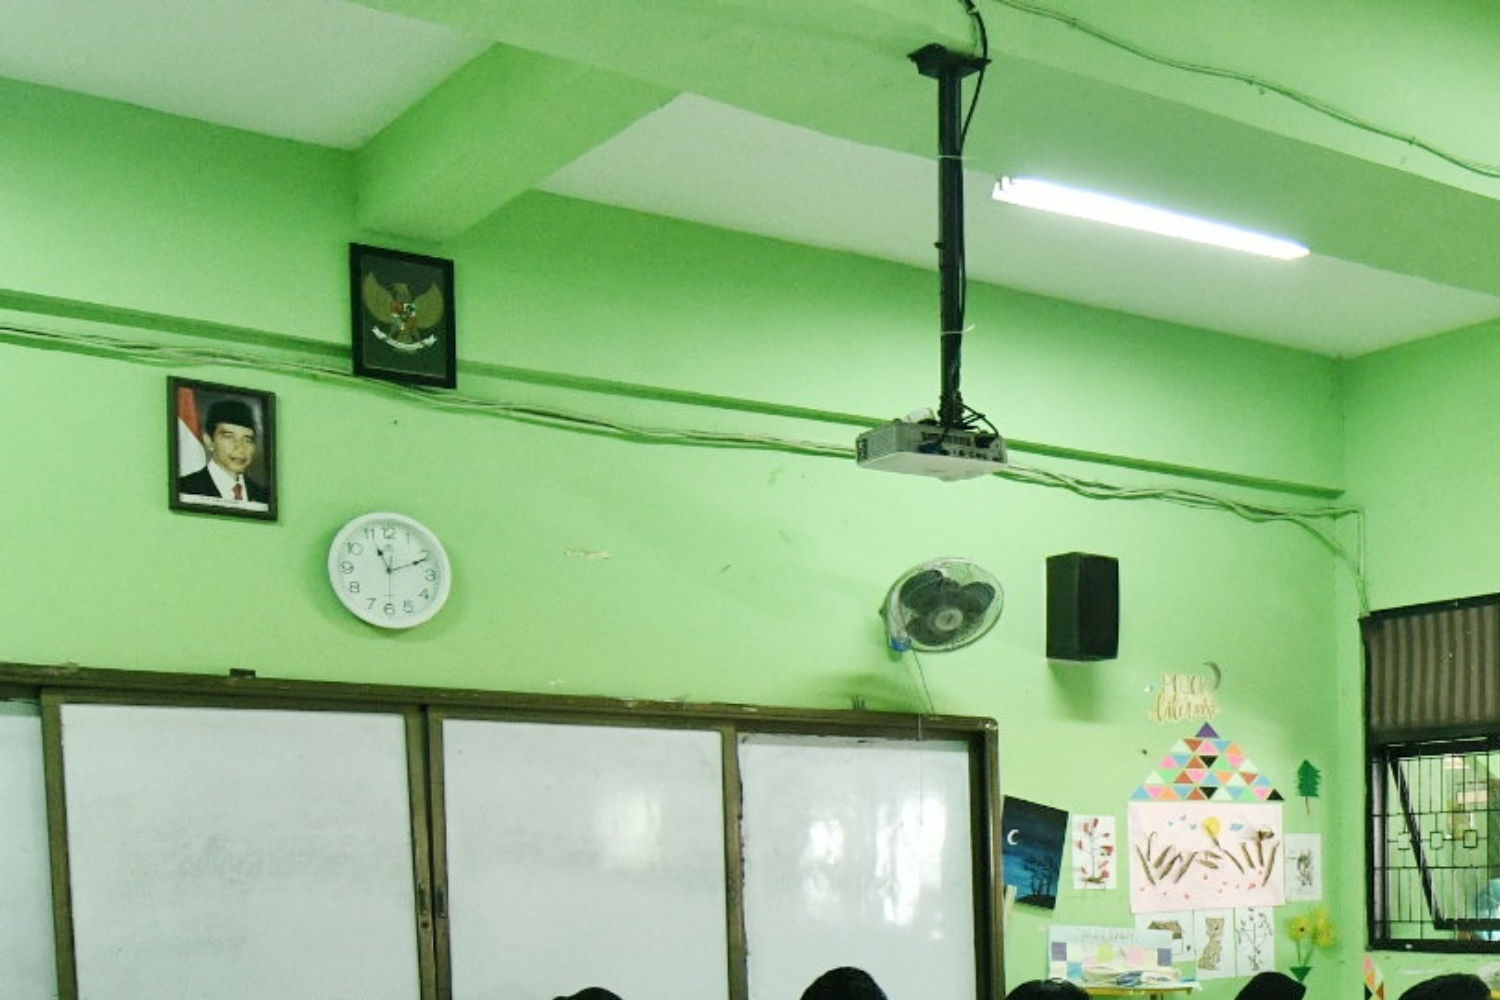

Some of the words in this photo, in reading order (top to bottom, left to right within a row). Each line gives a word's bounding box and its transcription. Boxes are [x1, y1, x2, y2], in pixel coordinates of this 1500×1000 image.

[364, 528, 375, 540] 11
[382, 527, 395, 539] 12
[406, 532, 411, 543] 1
[348, 542, 364, 556] 10
[341, 561, 354, 574] 9
[425, 569, 436, 582] 3
[349, 582, 360, 593] 8
[419, 588, 429, 600] 4
[365, 598, 377, 610] 7
[383, 603, 395, 616] 6
[403, 600, 414, 614] 5
